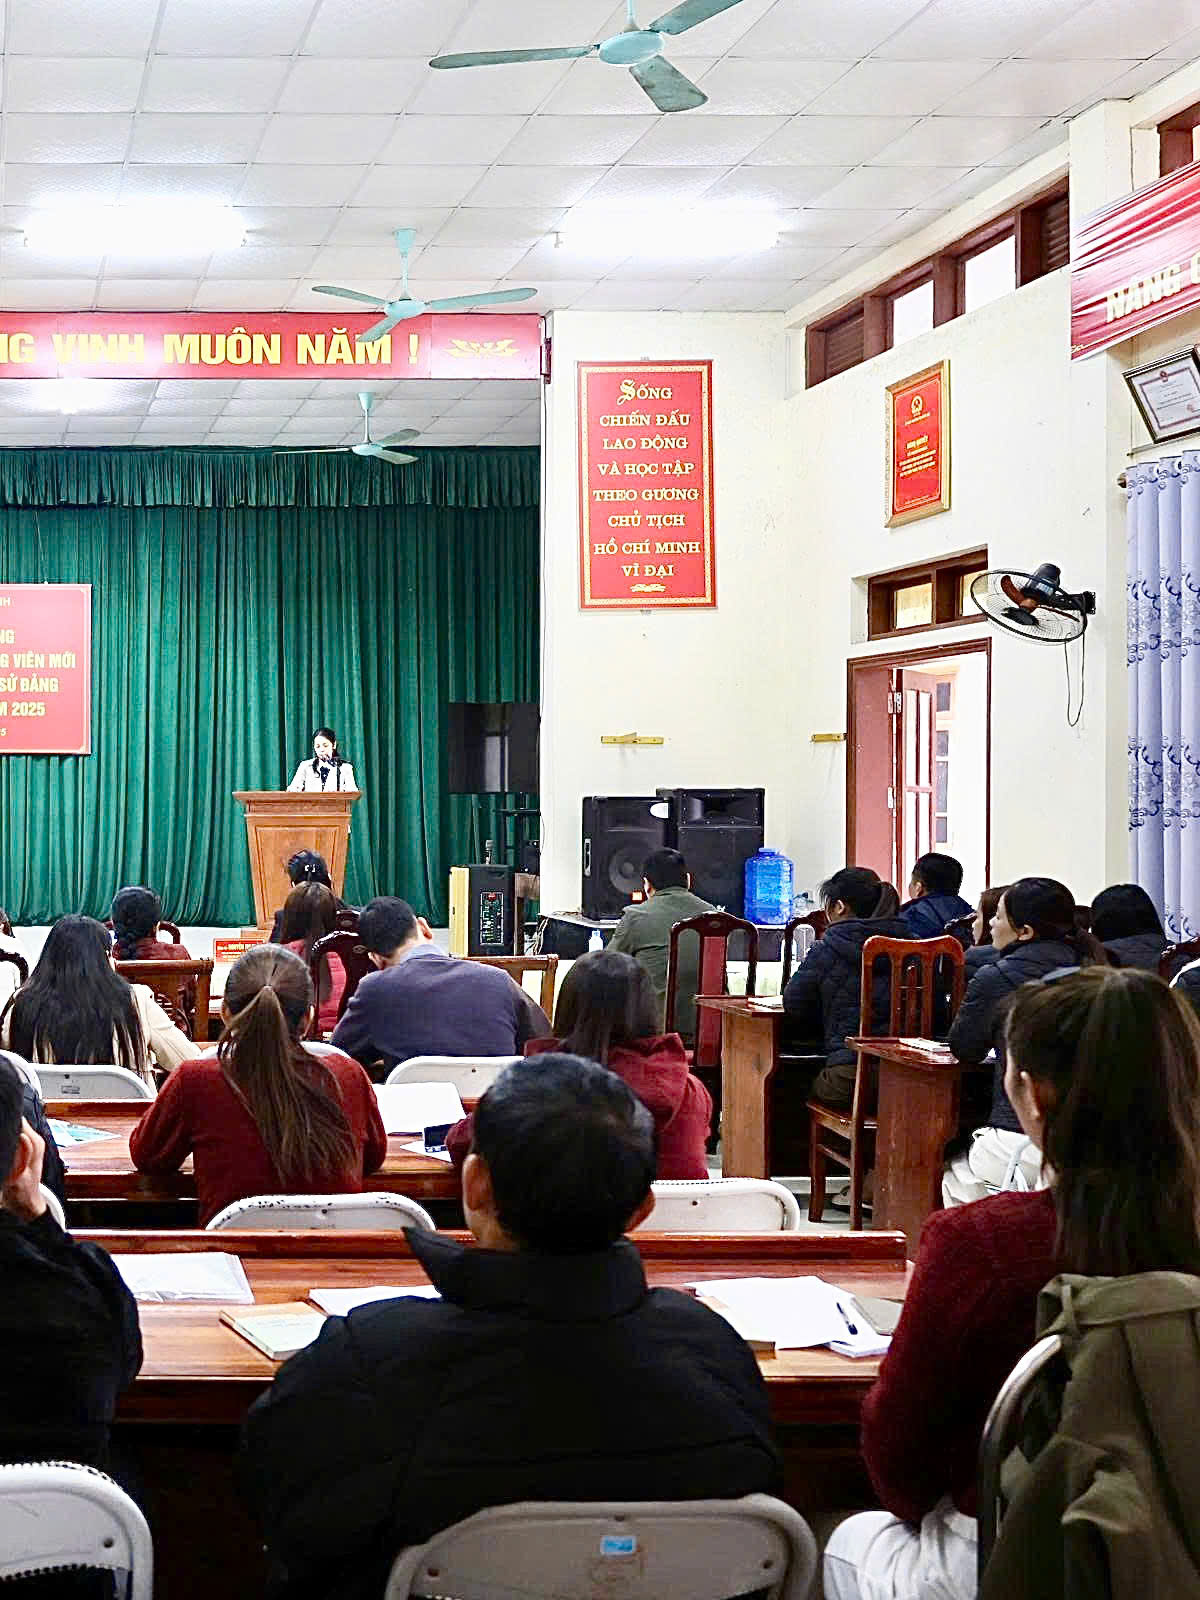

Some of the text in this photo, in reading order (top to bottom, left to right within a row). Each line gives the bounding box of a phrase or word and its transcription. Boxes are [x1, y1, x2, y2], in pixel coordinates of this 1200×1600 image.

[51, 333, 145, 363] VINH
[164, 327, 282, 366] MUÔN
[296, 327, 393, 365] NĂM
[407, 333, 419, 365] !
[616, 380, 673, 406] SỐNG
[599, 409, 691, 427] CHIẾN ĐẤU
[602, 434, 689, 452] LAO ĐỘNG
[597, 459, 695, 478] VÀ HỌC TẬP
[592, 488, 700, 502] THEO GƯƠNG
[607, 509, 686, 530] CHỦ TỊCH
[593, 537, 701, 555] HỒ CHÍ MINH
[643, 564, 675, 579] ĐẠI
[12, 651, 46, 669] VIÊN
[48, 651, 76, 669] MỚI
[20, 672, 59, 693] ĐẢNG
[11, 701, 47, 717] 2025
